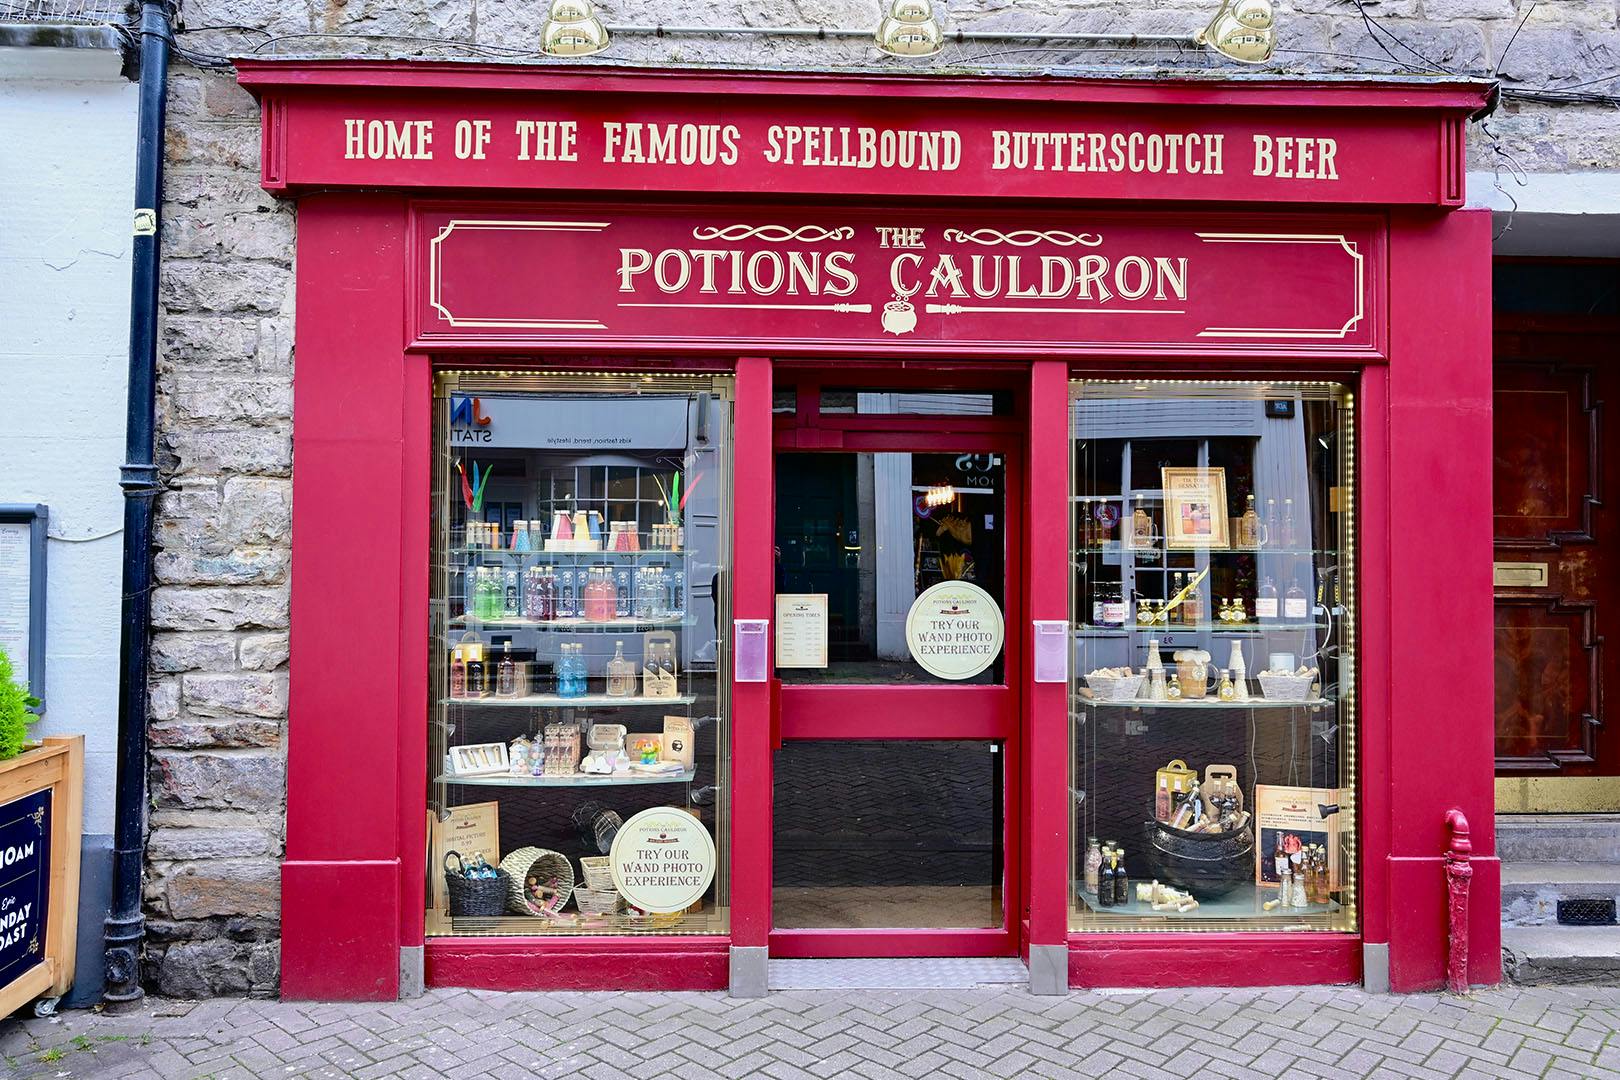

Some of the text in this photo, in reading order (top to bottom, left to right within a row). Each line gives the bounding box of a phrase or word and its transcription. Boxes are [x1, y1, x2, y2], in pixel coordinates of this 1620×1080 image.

[344, 119, 1339, 180] HOME OF THE FAMOUS SPELLBOUND BUTTERSCOTCH BEER
[875, 226, 926, 249] THE
[617, 247, 1189, 303] POTIONS CAULDRON
[930, 619, 980, 630] TRY OUR
[918, 632, 993, 642] WAND PHOTO
[920, 645, 991, 655] EXPERIENCE
[636, 848, 689, 860] TRY OUR
[622, 861, 703, 873] WAND PHOTO
[625, 875, 701, 887] EXPERIENCE
